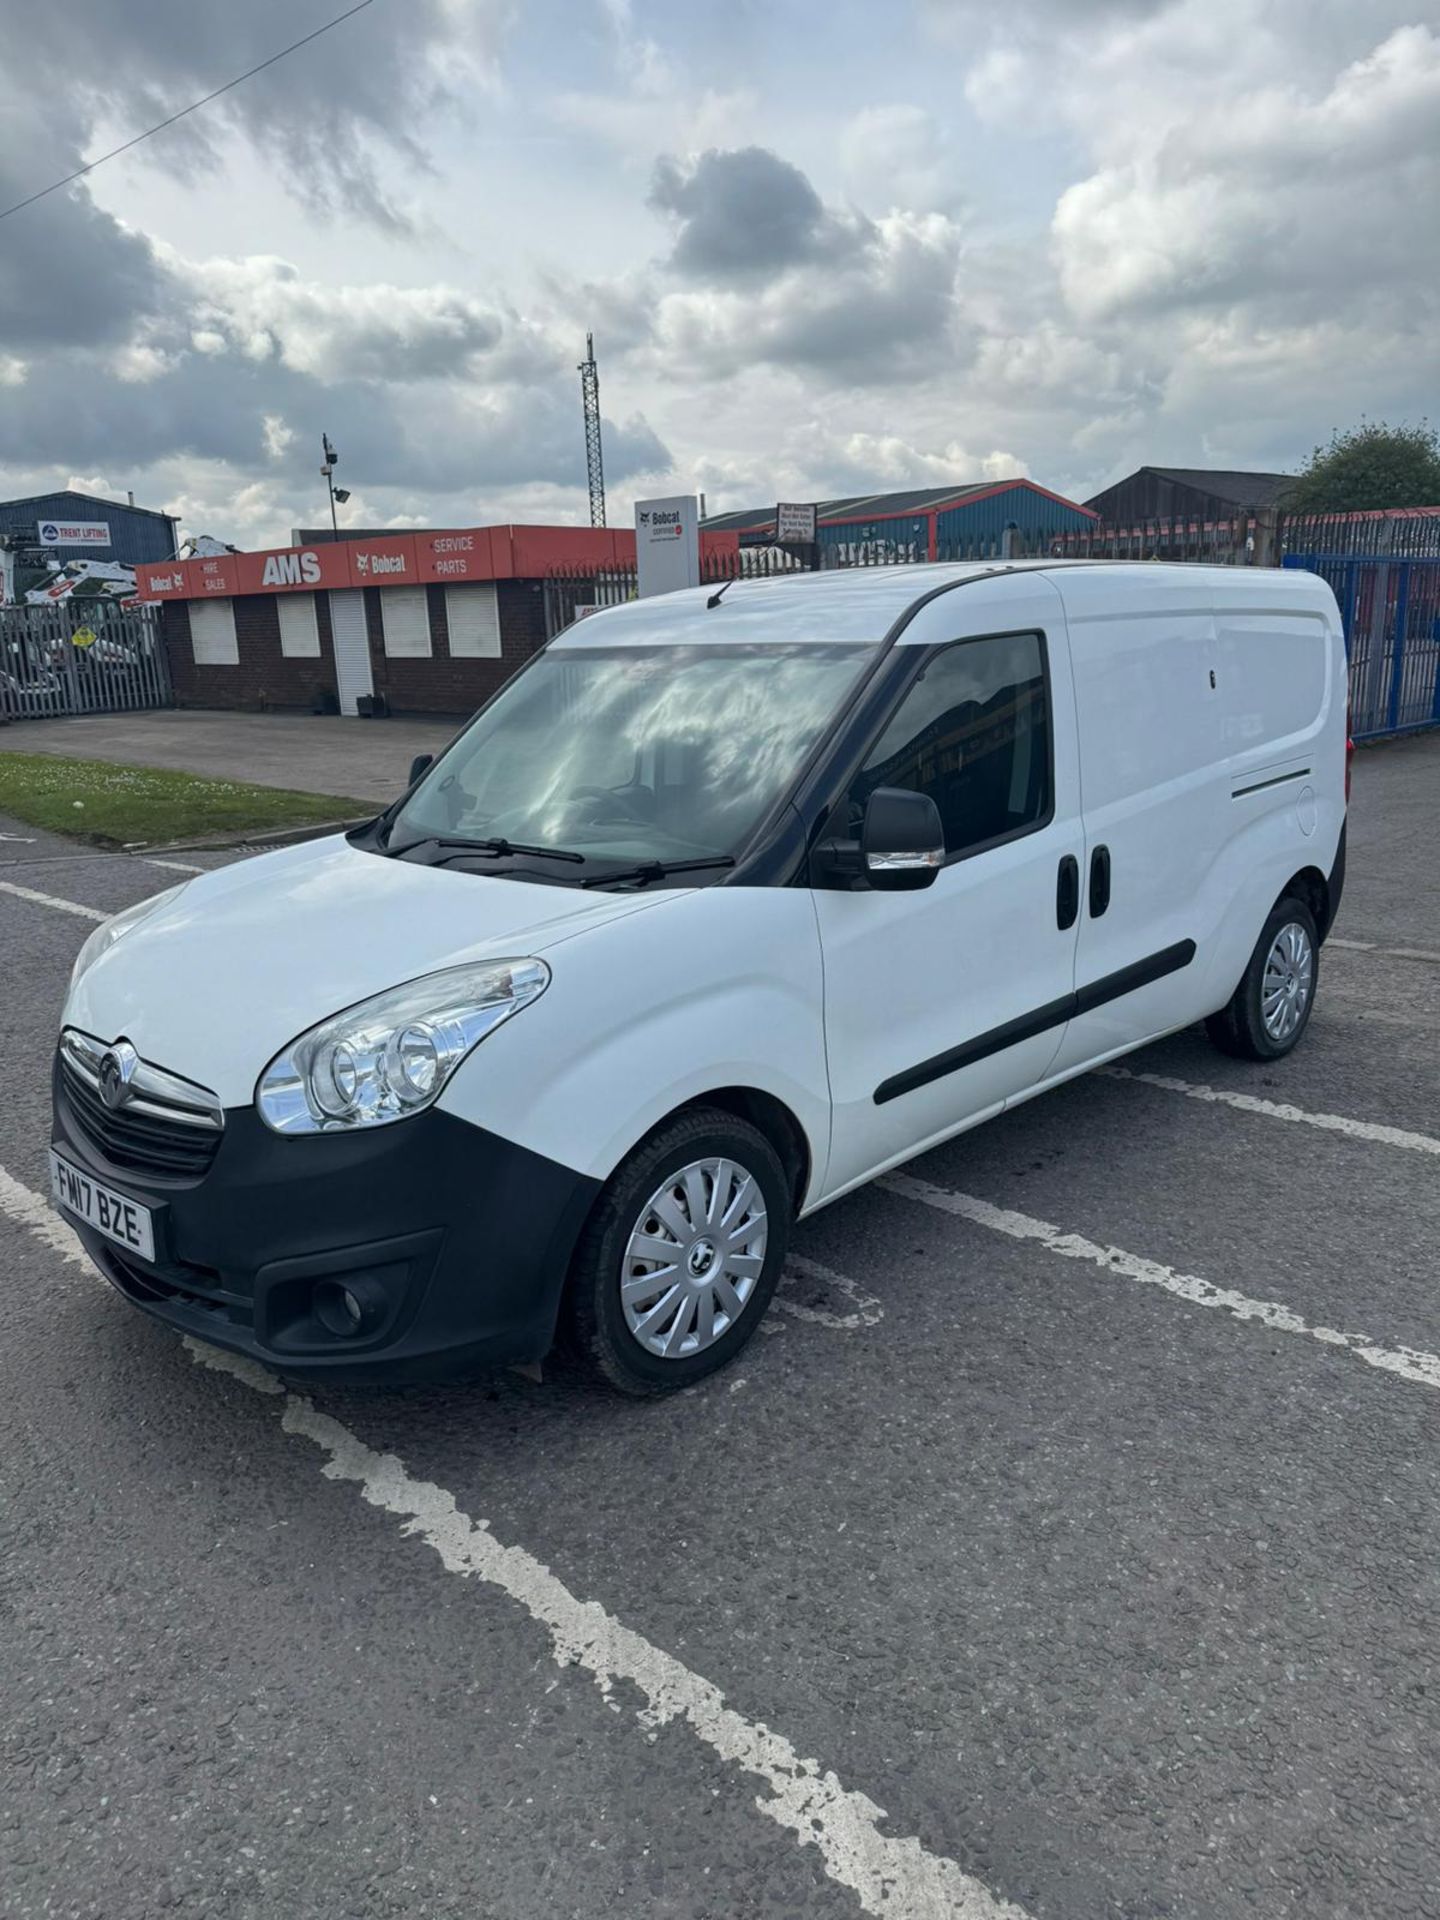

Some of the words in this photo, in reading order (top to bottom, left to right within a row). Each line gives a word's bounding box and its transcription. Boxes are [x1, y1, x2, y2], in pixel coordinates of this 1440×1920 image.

[652, 510, 680, 525] Bobcat
[60, 528, 81, 538] TRENT
[83, 528, 107, 538] LIFTING
[433, 535, 474, 553] SERVICE
[203, 562, 218, 574] HIRE
[262, 551, 322, 586] AMS
[371, 554, 406, 575] Bobcat
[436, 559, 467, 574] PARTS
[206, 578, 226, 591] SALES
[57, 1161, 91, 1217] FM17
[96, 1190, 139, 1246] BZE
